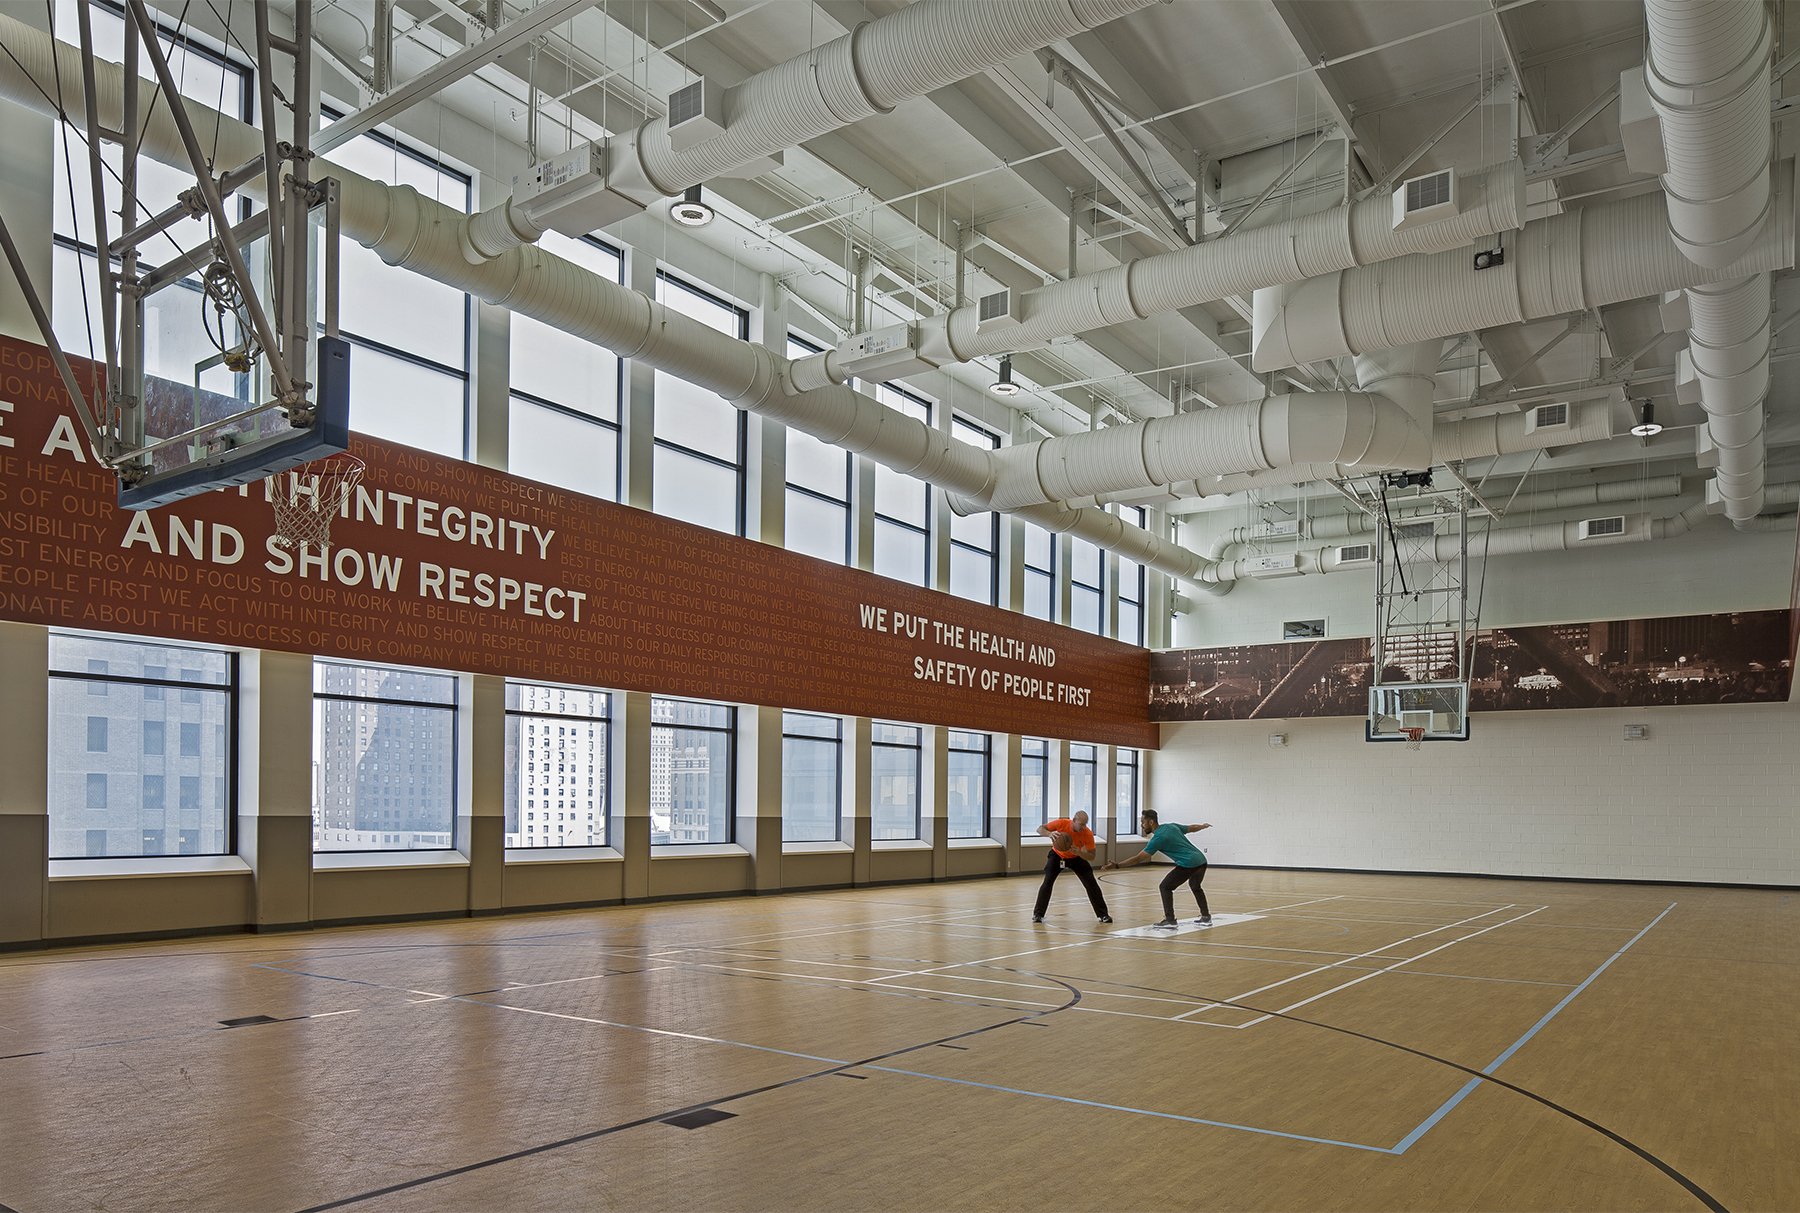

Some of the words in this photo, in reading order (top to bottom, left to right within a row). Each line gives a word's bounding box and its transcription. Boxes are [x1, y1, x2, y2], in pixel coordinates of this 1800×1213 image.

[18, 485, 51, 510] OF
[61, 493, 113, 521] OUR
[25, 460, 114, 495] HEALTH
[397, 451, 429, 474] AND
[435, 461, 478, 487] SHOW
[483, 473, 543, 503] RESPECT
[547, 490, 566, 509] WE
[569, 496, 592, 516] SEE
[596, 503, 620, 523] OUR
[624, 511, 657, 532] WORK
[660, 520, 709, 546] THROUGH
[712, 534, 731, 551] THE
[733, 540, 756, 558] EYES
[759, 547, 770, 561] OF
[341, 479, 555, 563] INTEGRITY
[394, 471, 470, 505] COMPANY
[475, 491, 496, 511] WE
[500, 498, 527, 518] PUT
[531, 505, 556, 526] THE
[561, 513, 608, 538] HEALTH
[612, 526, 636, 545] AND
[640, 533, 681, 555] SAFETY
[683, 544, 697, 559] OF
[700, 548, 737, 569] PEOPLE
[739, 558, 766, 576] FIRST
[767, 565, 780, 579] WE
[119, 503, 246, 569] AND
[263, 531, 403, 595] SHOW
[419, 560, 586, 624] RESPECT
[560, 532, 579, 550] WE
[583, 537, 633, 562] BELIEVE
[634, 549, 662, 568] THAT
[664, 556, 735, 584] IMPROVEMENT
[737, 573, 745, 587] IS
[748, 576, 766, 592] OUR
[560, 550, 590, 570] BEST
[593, 558, 639, 581] ENERGY
[642, 569, 665, 586] AND
[668, 574, 701, 594] FOCUS
[704, 582, 717, 597] TO
[719, 585, 740, 602] OUR
[741, 590, 768, 608] WORK
[770, 597, 784, 611] WE
[40, 543, 133, 576] ENERGY
[143, 559, 188, 584] AND
[195, 567, 262, 595] FOCUS
[268, 579, 293, 599] TO
[298, 584, 335, 606] OUR
[342, 591, 392, 614] WORK
[398, 599, 421, 618] WE
[426, 604, 486, 628] BELIEVE
[490, 614, 526, 634] THAT
[529, 620, 619, 648] IMPROVEMENT
[623, 635, 633, 650] IS
[636, 637, 659, 653] OUR
[662, 641, 691, 658] DAILY
[694, 646, 769, 670] RESPONSIBILITY
[771, 659, 785, 672] WE
[561, 569, 591, 589] EYES
[594, 576, 608, 592] OF
[612, 580, 649, 600] THOSE
[651, 588, 667, 604] WE
[669, 591, 700, 610] SERVE
[703, 598, 718, 613] WE
[720, 602, 747, 619] BRING
[749, 608, 767, 623] OUR
[590, 594, 608, 610] WE
[611, 598, 634, 615] ACT
[637, 602, 664, 620] WITH
[666, 608, 718, 630] INTEGRITY
[720, 618, 740, 634] AND
[743, 622, 769, 639] SHOW
[82, 601, 160, 629] ABOUT
[167, 612, 208, 634] THE
[215, 618, 302, 645] SUCCESS
[307, 630, 329, 649] OF
[335, 633, 371, 654] OUR
[377, 639, 453, 663] COMPANY
[458, 649, 480, 666] WE
[484, 652, 511, 670] PUT
[515, 656, 540, 673] THE
[544, 660, 591, 679] HEALTH
[595, 667, 619, 683] AND
[623, 670, 664, 688] SAFETY
[667, 676, 681, 690] OF
[684, 678, 721, 695] PEOPLE
[723, 683, 749, 698] FIRST
[751, 687, 765, 700] WE
[767, 689, 784, 702] ACT
[89, 576, 152, 603] FIRST
[160, 586, 191, 608] WE
[199, 592, 239, 614] ACT
[245, 598, 293, 621] WITH
[300, 606, 389, 634] INTEGRITY
[395, 620, 428, 639] AND
[433, 625, 477, 646] SHOW
[481, 632, 541, 654] RESPECT
[545, 641, 564, 657] WE
[568, 644, 591, 661] SEE
[594, 648, 619, 665] OUR
[622, 652, 656, 670] WORK
[658, 657, 708, 677] THROUGH
[711, 665, 730, 679] THE
[732, 668, 755, 683] EYES
[757, 672, 769, 685] OF
[589, 612, 627, 631] ABOUT
[631, 619, 652, 635] THE
[654, 623, 700, 643] SUCCESS
[702, 631, 714, 645] OF
[716, 634, 737, 649] OUR
[739, 638, 780, 656] COMPANY
[859, 602, 887, 633] WE
[893, 610, 928, 642] PUT
[932, 619, 964, 649] THE
[969, 628, 1024, 662] HEALTH
[1027, 641, 1055, 668] AND
[913, 654, 976, 689] SAFETY
[980, 667, 1000, 693] OF
[1003, 671, 1054, 701] PEOPLE
[1057, 681, 1091, 707] FIRST
